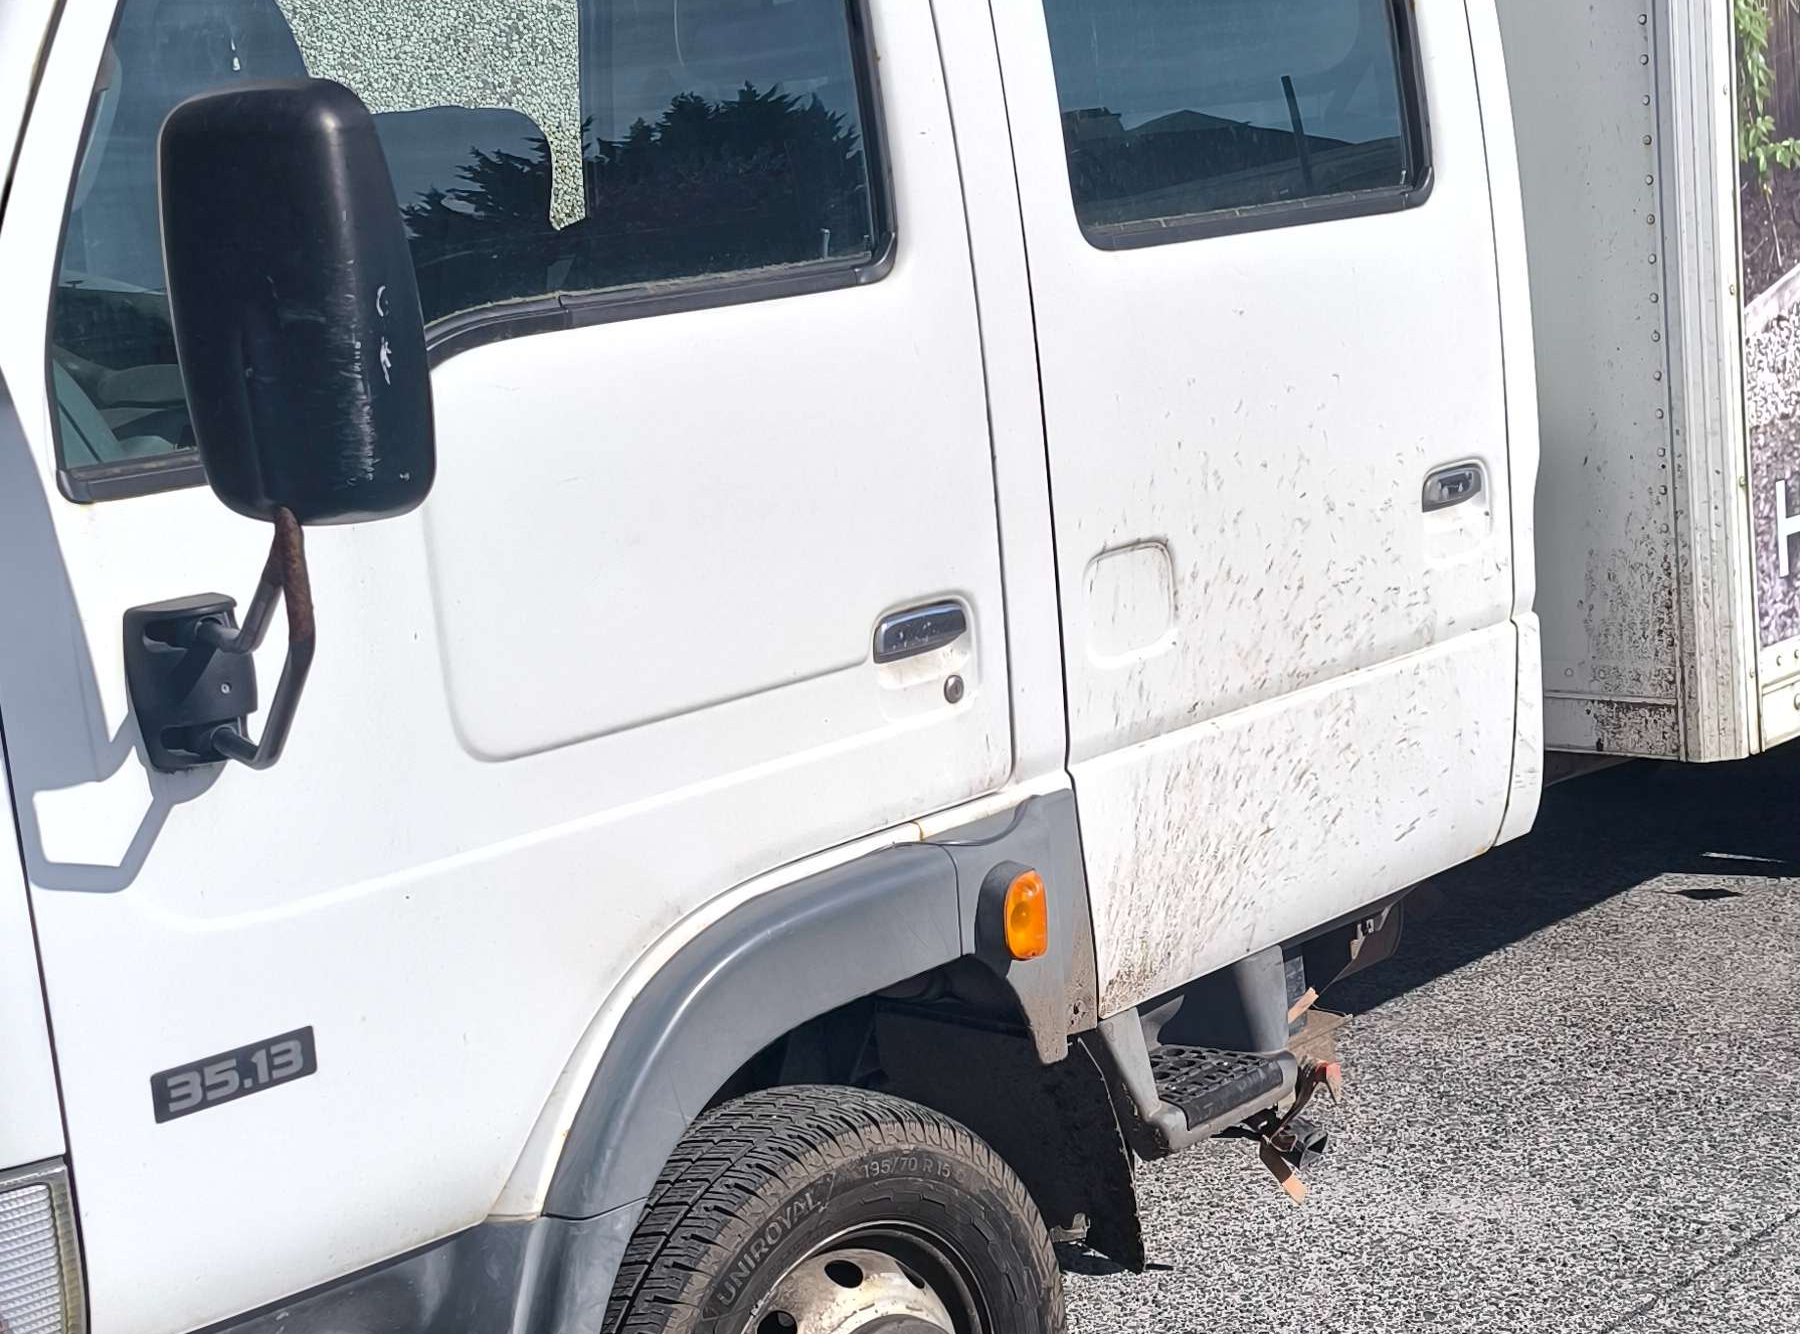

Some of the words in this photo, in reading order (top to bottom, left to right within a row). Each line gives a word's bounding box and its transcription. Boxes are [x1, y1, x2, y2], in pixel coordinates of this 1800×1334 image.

[166, 1039, 304, 1113] 35.13
[863, 1156, 918, 1178] 195/70
[716, 1192, 822, 1305] UNIROYAL
